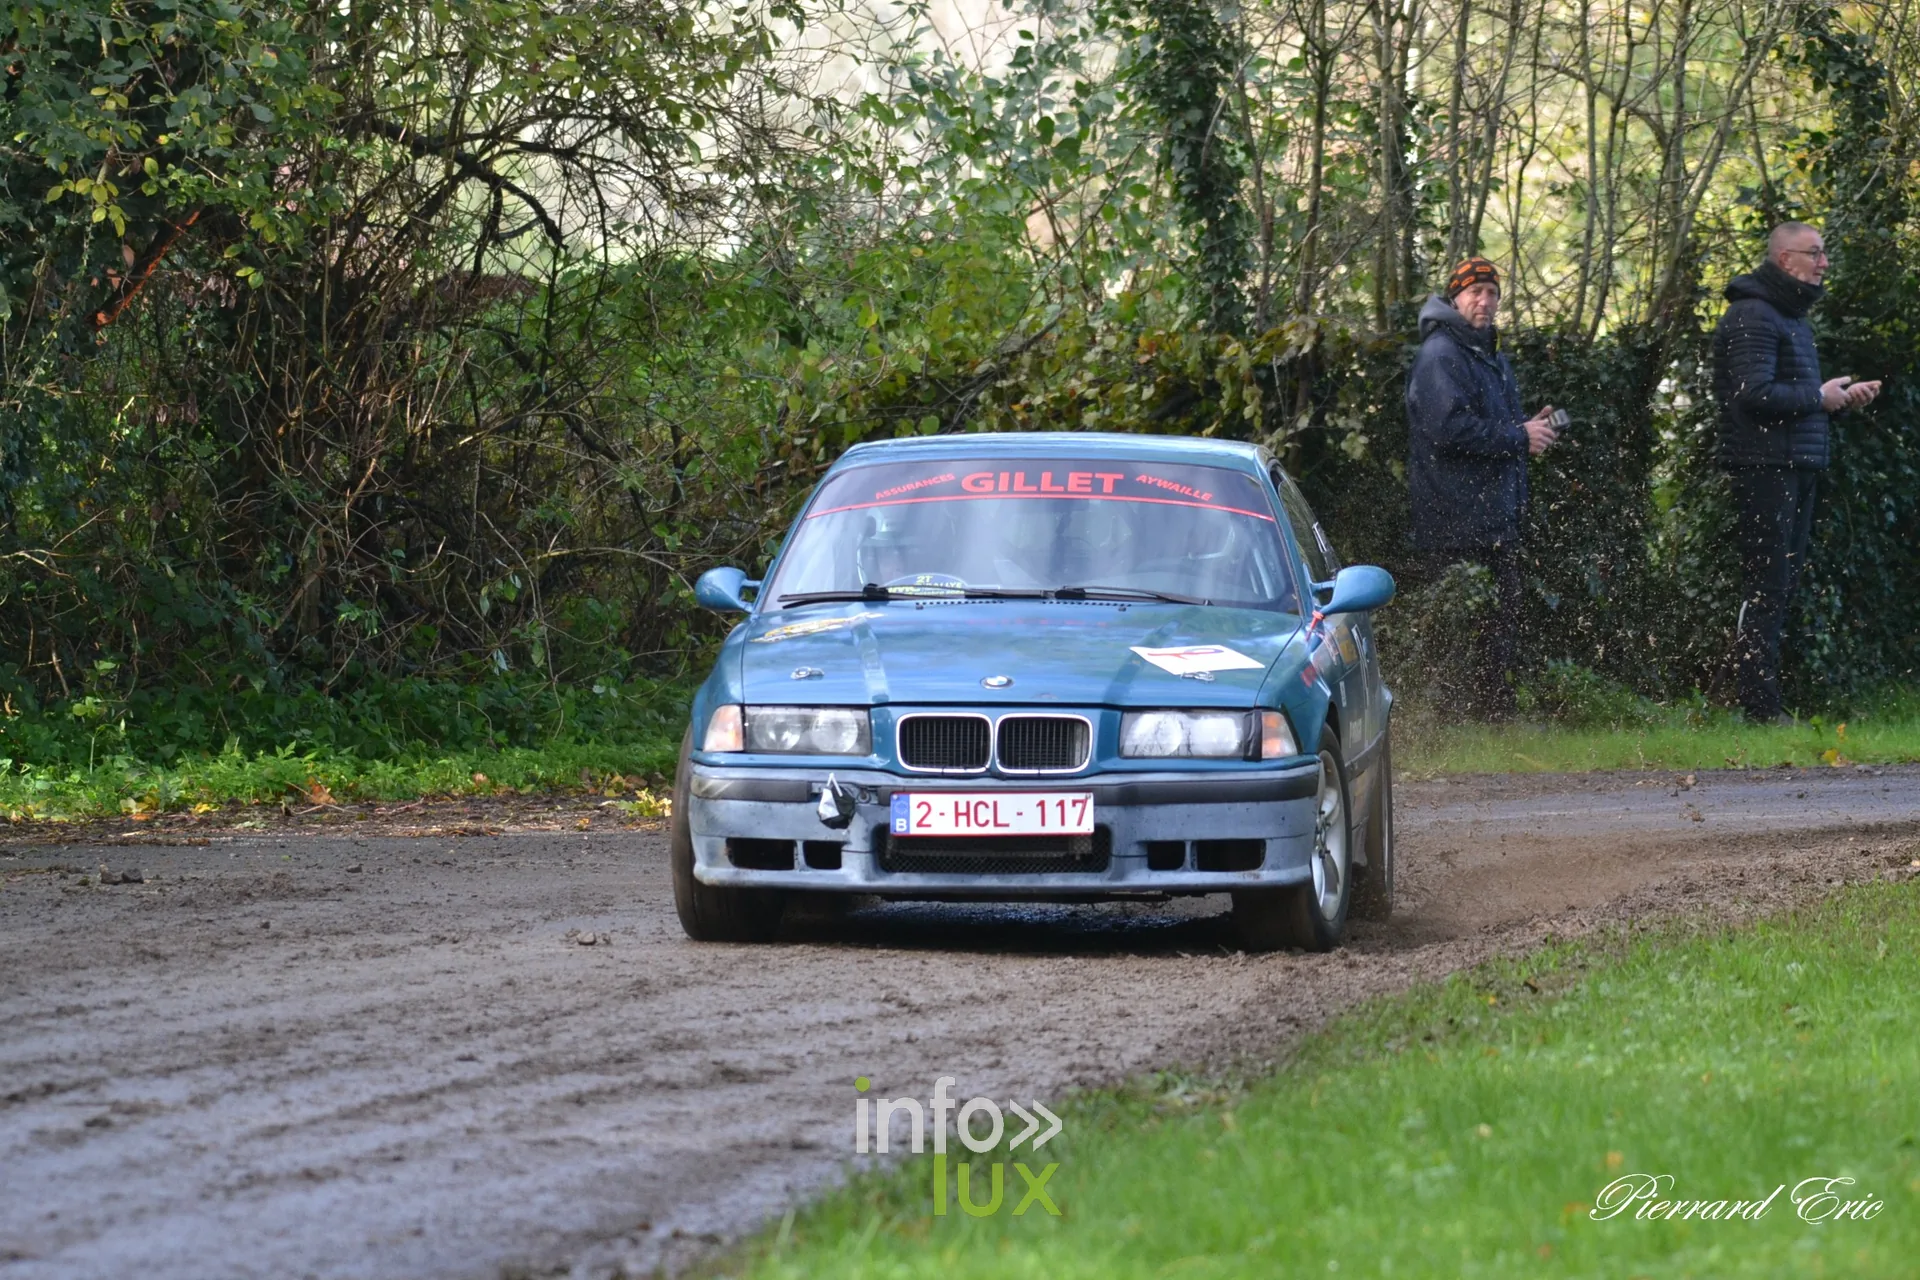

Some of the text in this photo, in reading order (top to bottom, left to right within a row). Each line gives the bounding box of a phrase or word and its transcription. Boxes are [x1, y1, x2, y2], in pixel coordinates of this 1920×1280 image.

[875, 472, 1213, 501] ASSURANCES GILLET AYWAILLE
[895, 818, 908, 831] B
